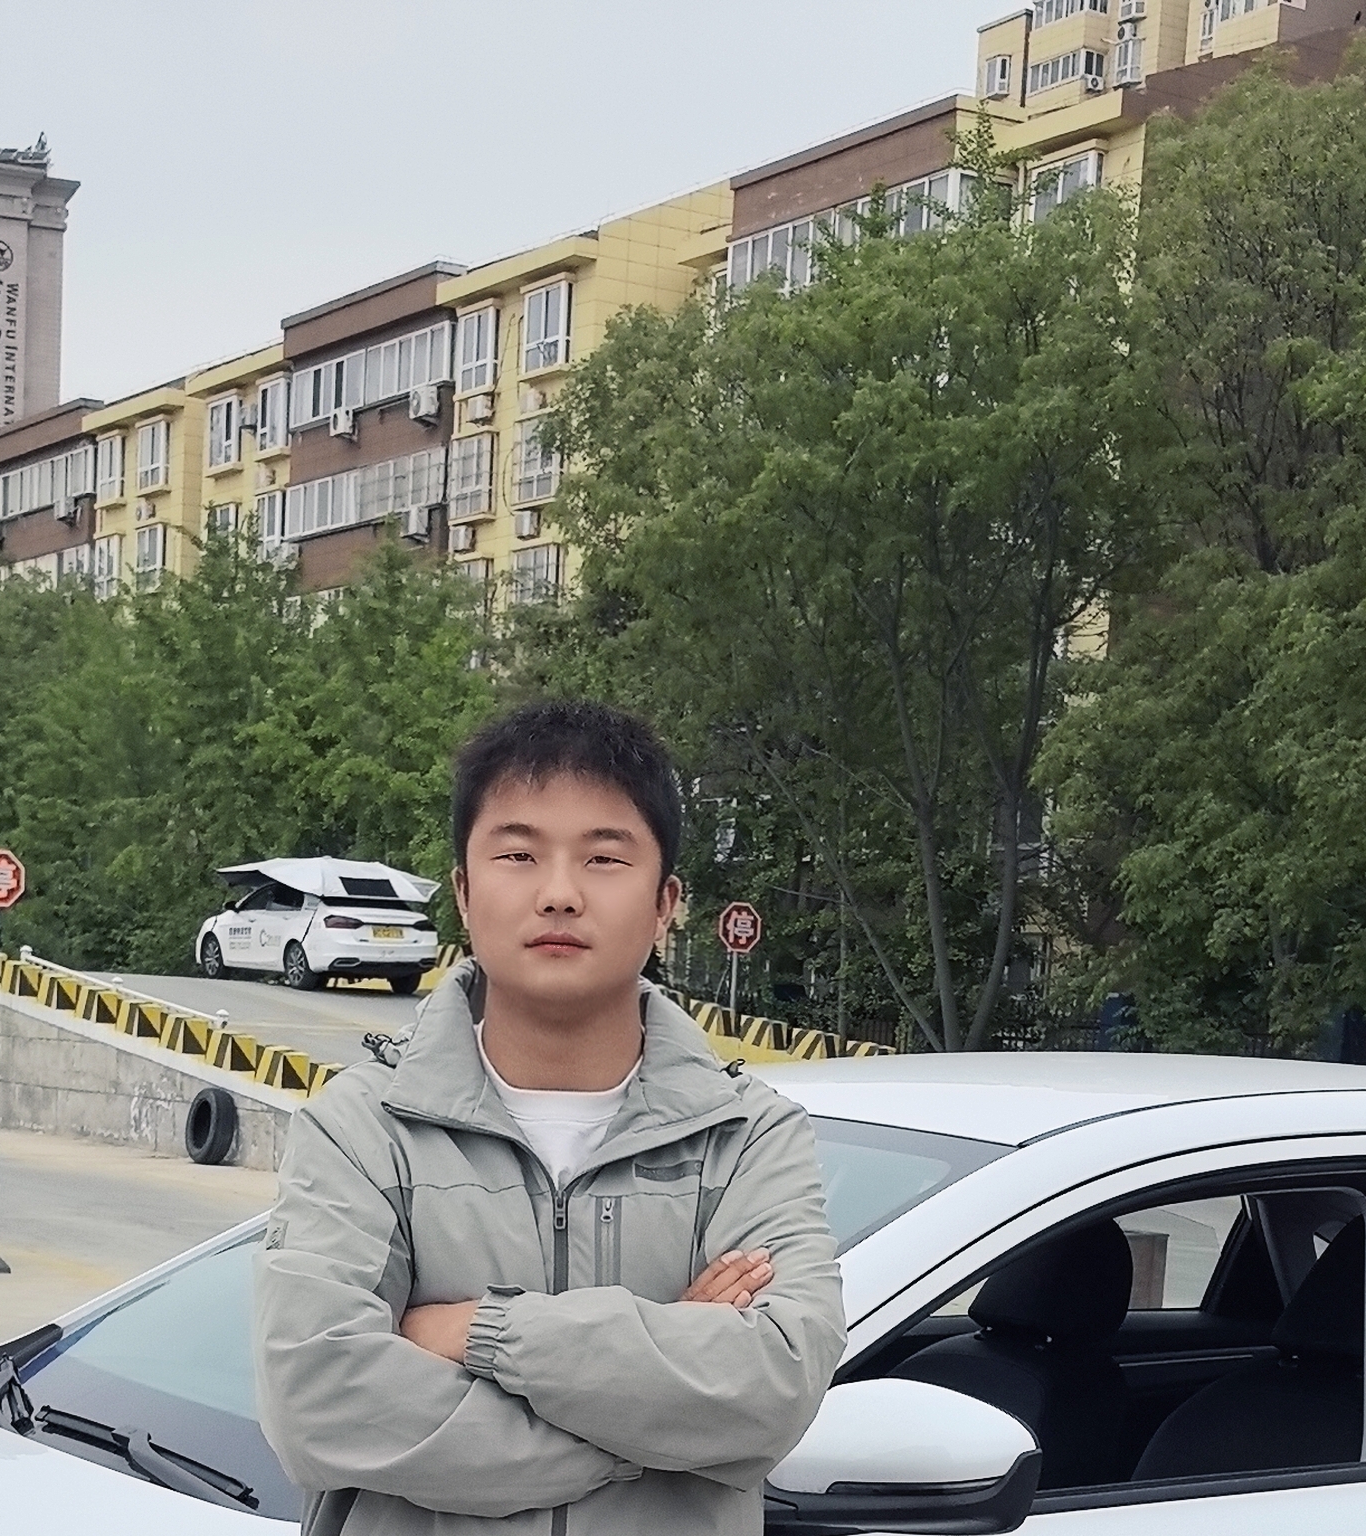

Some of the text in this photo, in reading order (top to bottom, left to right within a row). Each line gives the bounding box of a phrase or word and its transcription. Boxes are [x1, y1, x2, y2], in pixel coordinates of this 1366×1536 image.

[2, 283, 20, 425] WANFU INTERNA
[725, 910, 755, 945] 停
